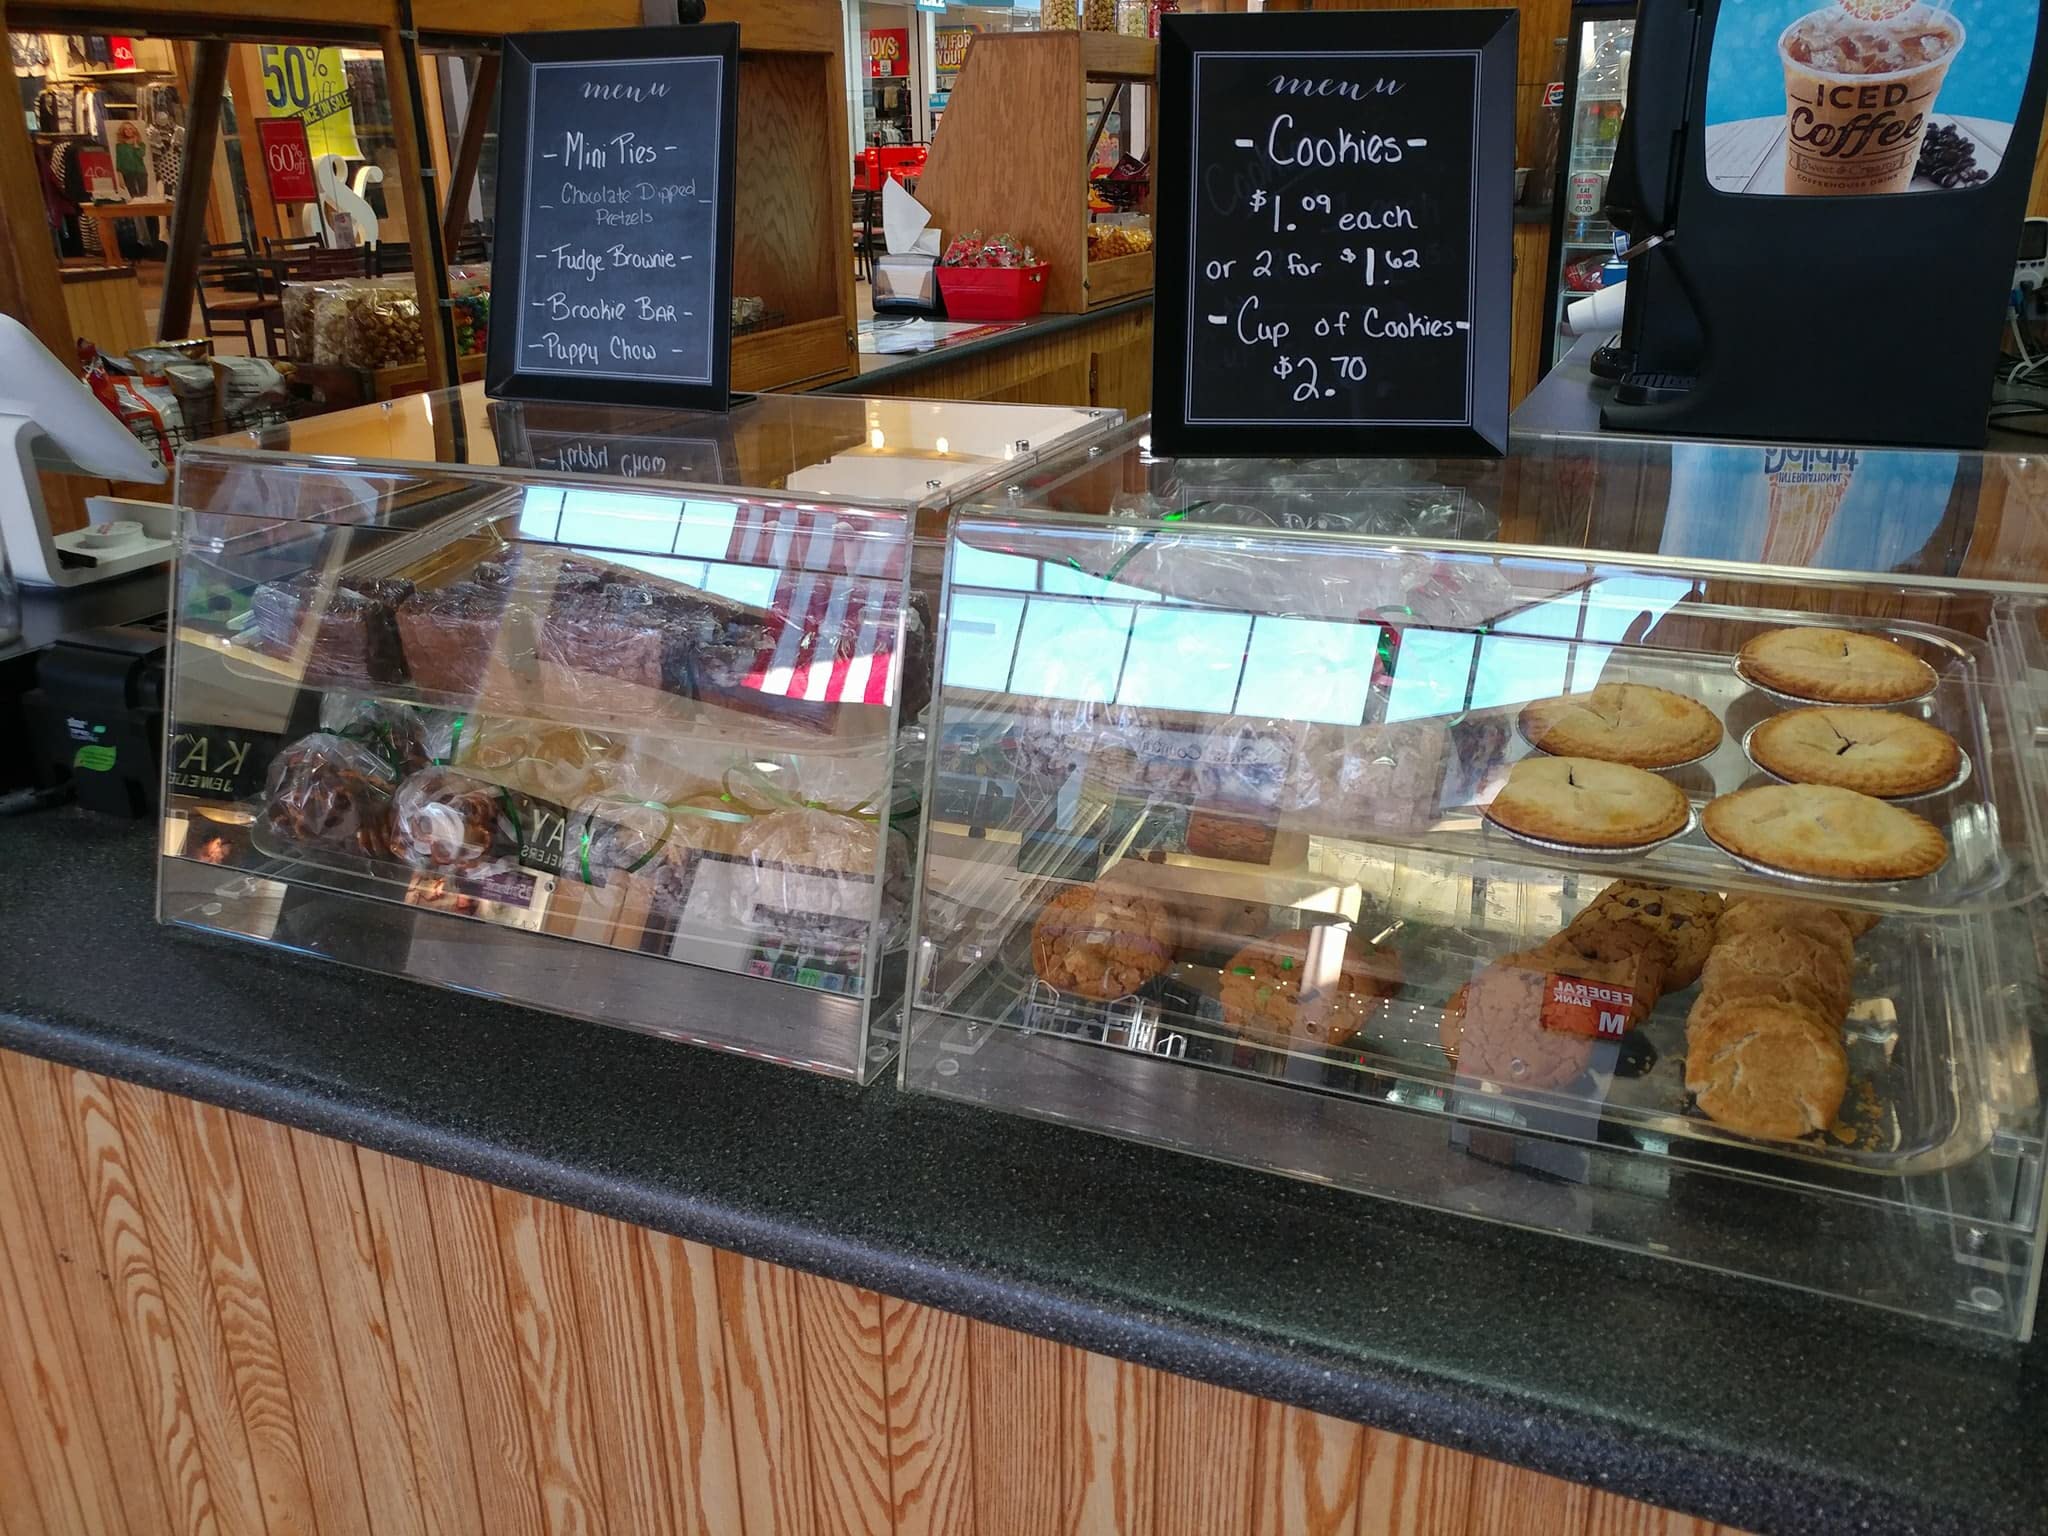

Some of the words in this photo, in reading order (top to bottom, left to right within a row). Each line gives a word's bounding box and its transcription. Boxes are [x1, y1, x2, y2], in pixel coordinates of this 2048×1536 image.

[938, 50, 960, 65] YOU!
[583, 82, 671, 102] menu
[1267, 74, 1406, 100] menu
[1817, 84, 1908, 109] ICED
[1269, 114, 1402, 166] Cookies
[1791, 106, 1924, 159] Coffee
[269, 143, 303, 172] 60%
[565, 131, 606, 170] Mini
[611, 132, 657, 164] Pies
[561, 182, 632, 204] Chocolate
[635, 178, 697, 204] Dipped
[596, 208, 654, 226] Pretzels
[1339, 206, 1418, 231] each
[551, 243, 605, 282] Fudge
[606, 244, 676, 268] Brownie
[1206, 260, 1236, 279] or
[1253, 250, 1273, 277] 2
[1287, 253, 1322, 277] for
[1340, 247, 1421, 286] $1.62
[547, 292, 626, 321] Brookie
[1237, 295, 1290, 347] Cup
[1314, 312, 1350, 336] of
[1364, 307, 1453, 338] Cookies
[542, 332, 599, 365] Puppy
[610, 336, 656, 360] Chow
[1273, 356, 1367, 401] $2.70
